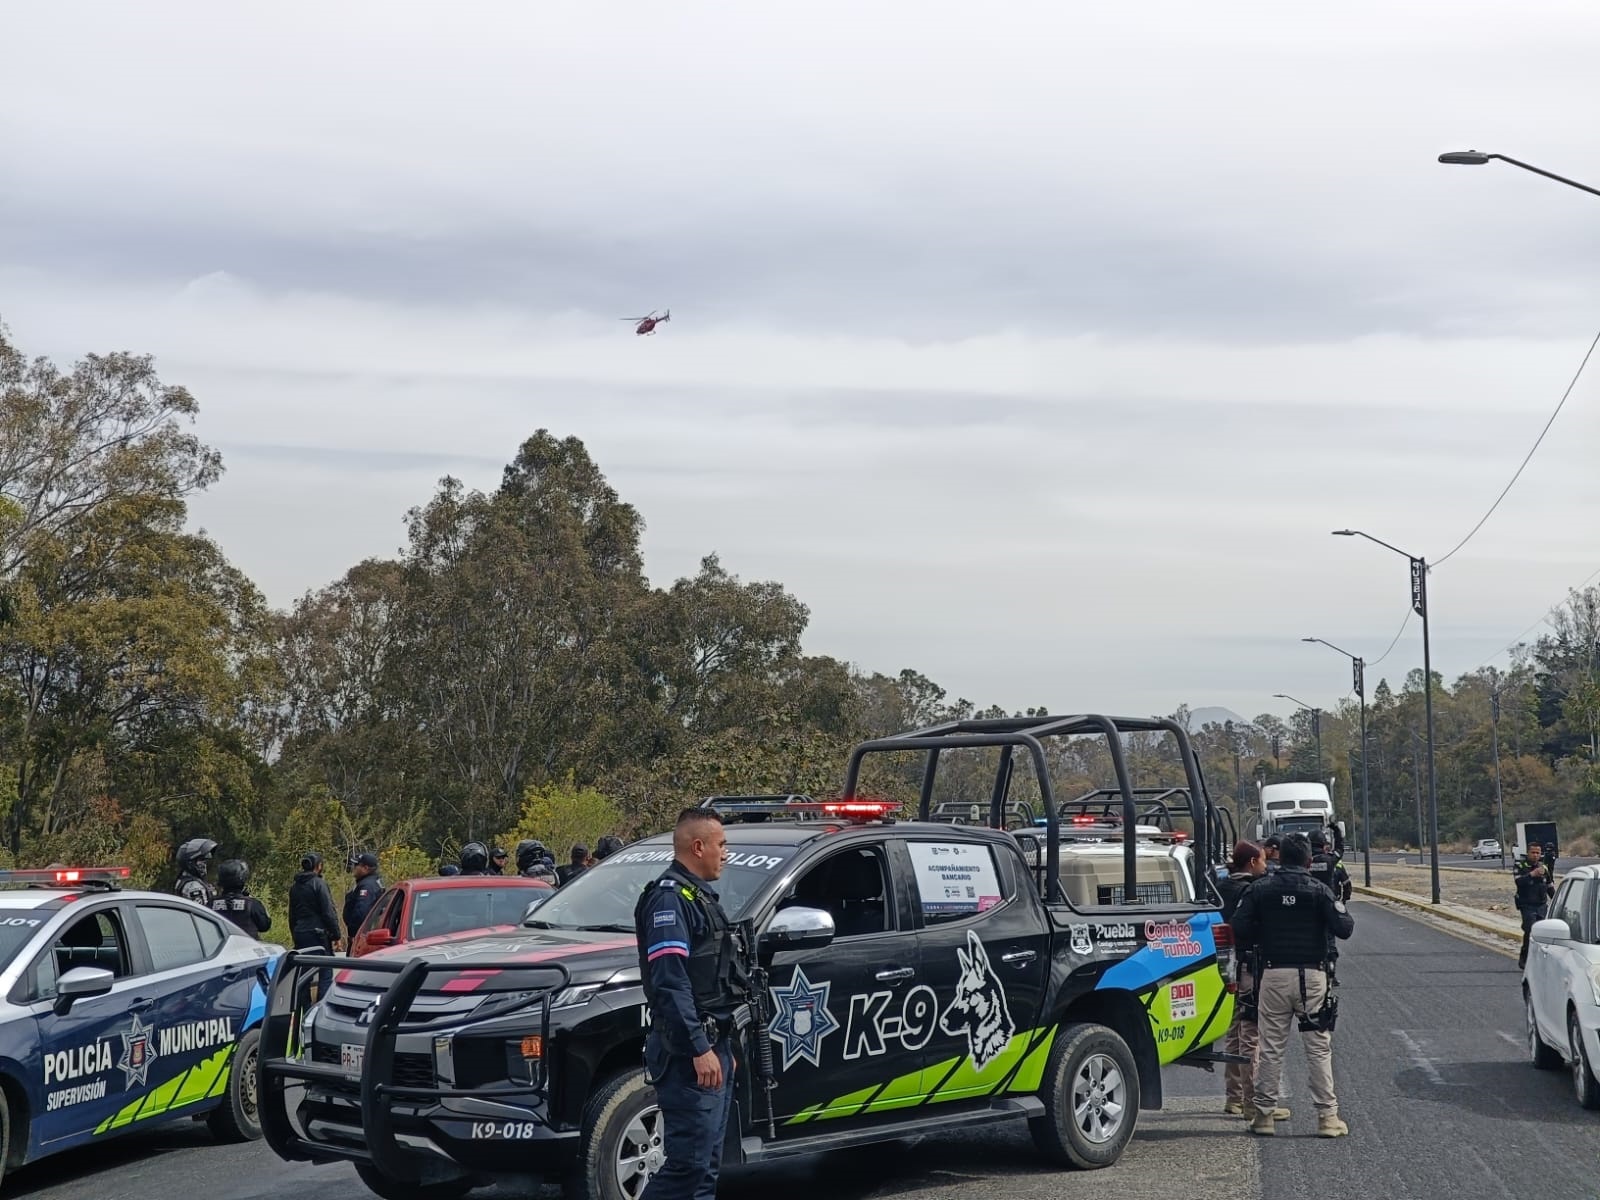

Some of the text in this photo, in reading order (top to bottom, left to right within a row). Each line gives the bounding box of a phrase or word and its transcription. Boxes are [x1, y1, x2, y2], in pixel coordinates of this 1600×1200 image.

[928, 864, 981, 873] ACOMPAÑAMIENTO
[1282, 895, 1296, 905] K9
[1095, 923, 1136, 938] Puebla
[1145, 919, 1192, 942] Contigo
[1164, 941, 1201, 957] rumbo
[1171, 984, 1193, 999] 911
[843, 984, 939, 1060] K-9
[1158, 1025, 1185, 1043] K9-018
[44, 1016, 236, 1086] POLICÍA MUNICIPAL
[46, 1079, 106, 1112] SUPERVISIÓN
[471, 1122, 534, 1139] K9-018
